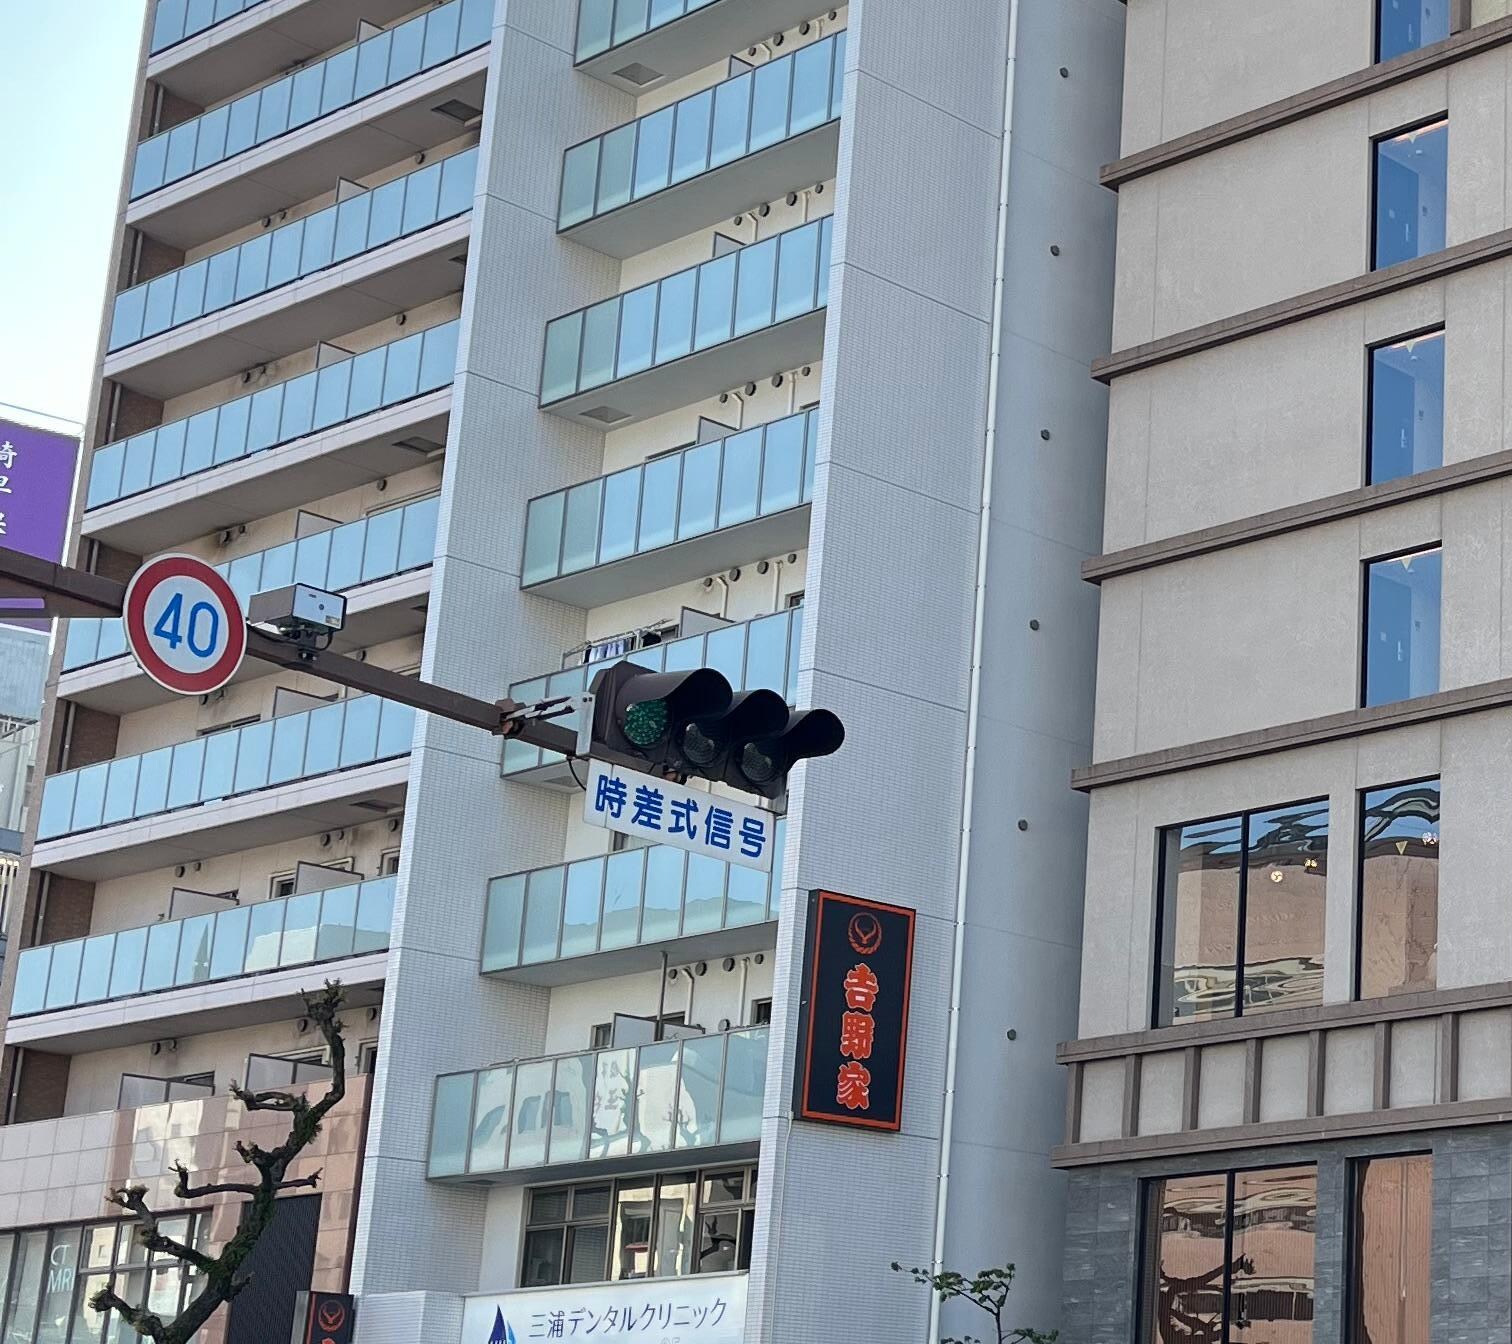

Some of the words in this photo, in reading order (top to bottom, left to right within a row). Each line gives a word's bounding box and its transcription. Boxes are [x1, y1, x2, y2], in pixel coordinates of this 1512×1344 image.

[153, 591, 220, 659] 40
[593, 772, 768, 860] 時差式信号
[836, 962, 880, 1110] 吉野家
[47, 1267, 76, 1294] MRI
[50, 1244, 72, 1266] CT
[528, 1297, 728, 1340] 三浦デンタルクリニック
